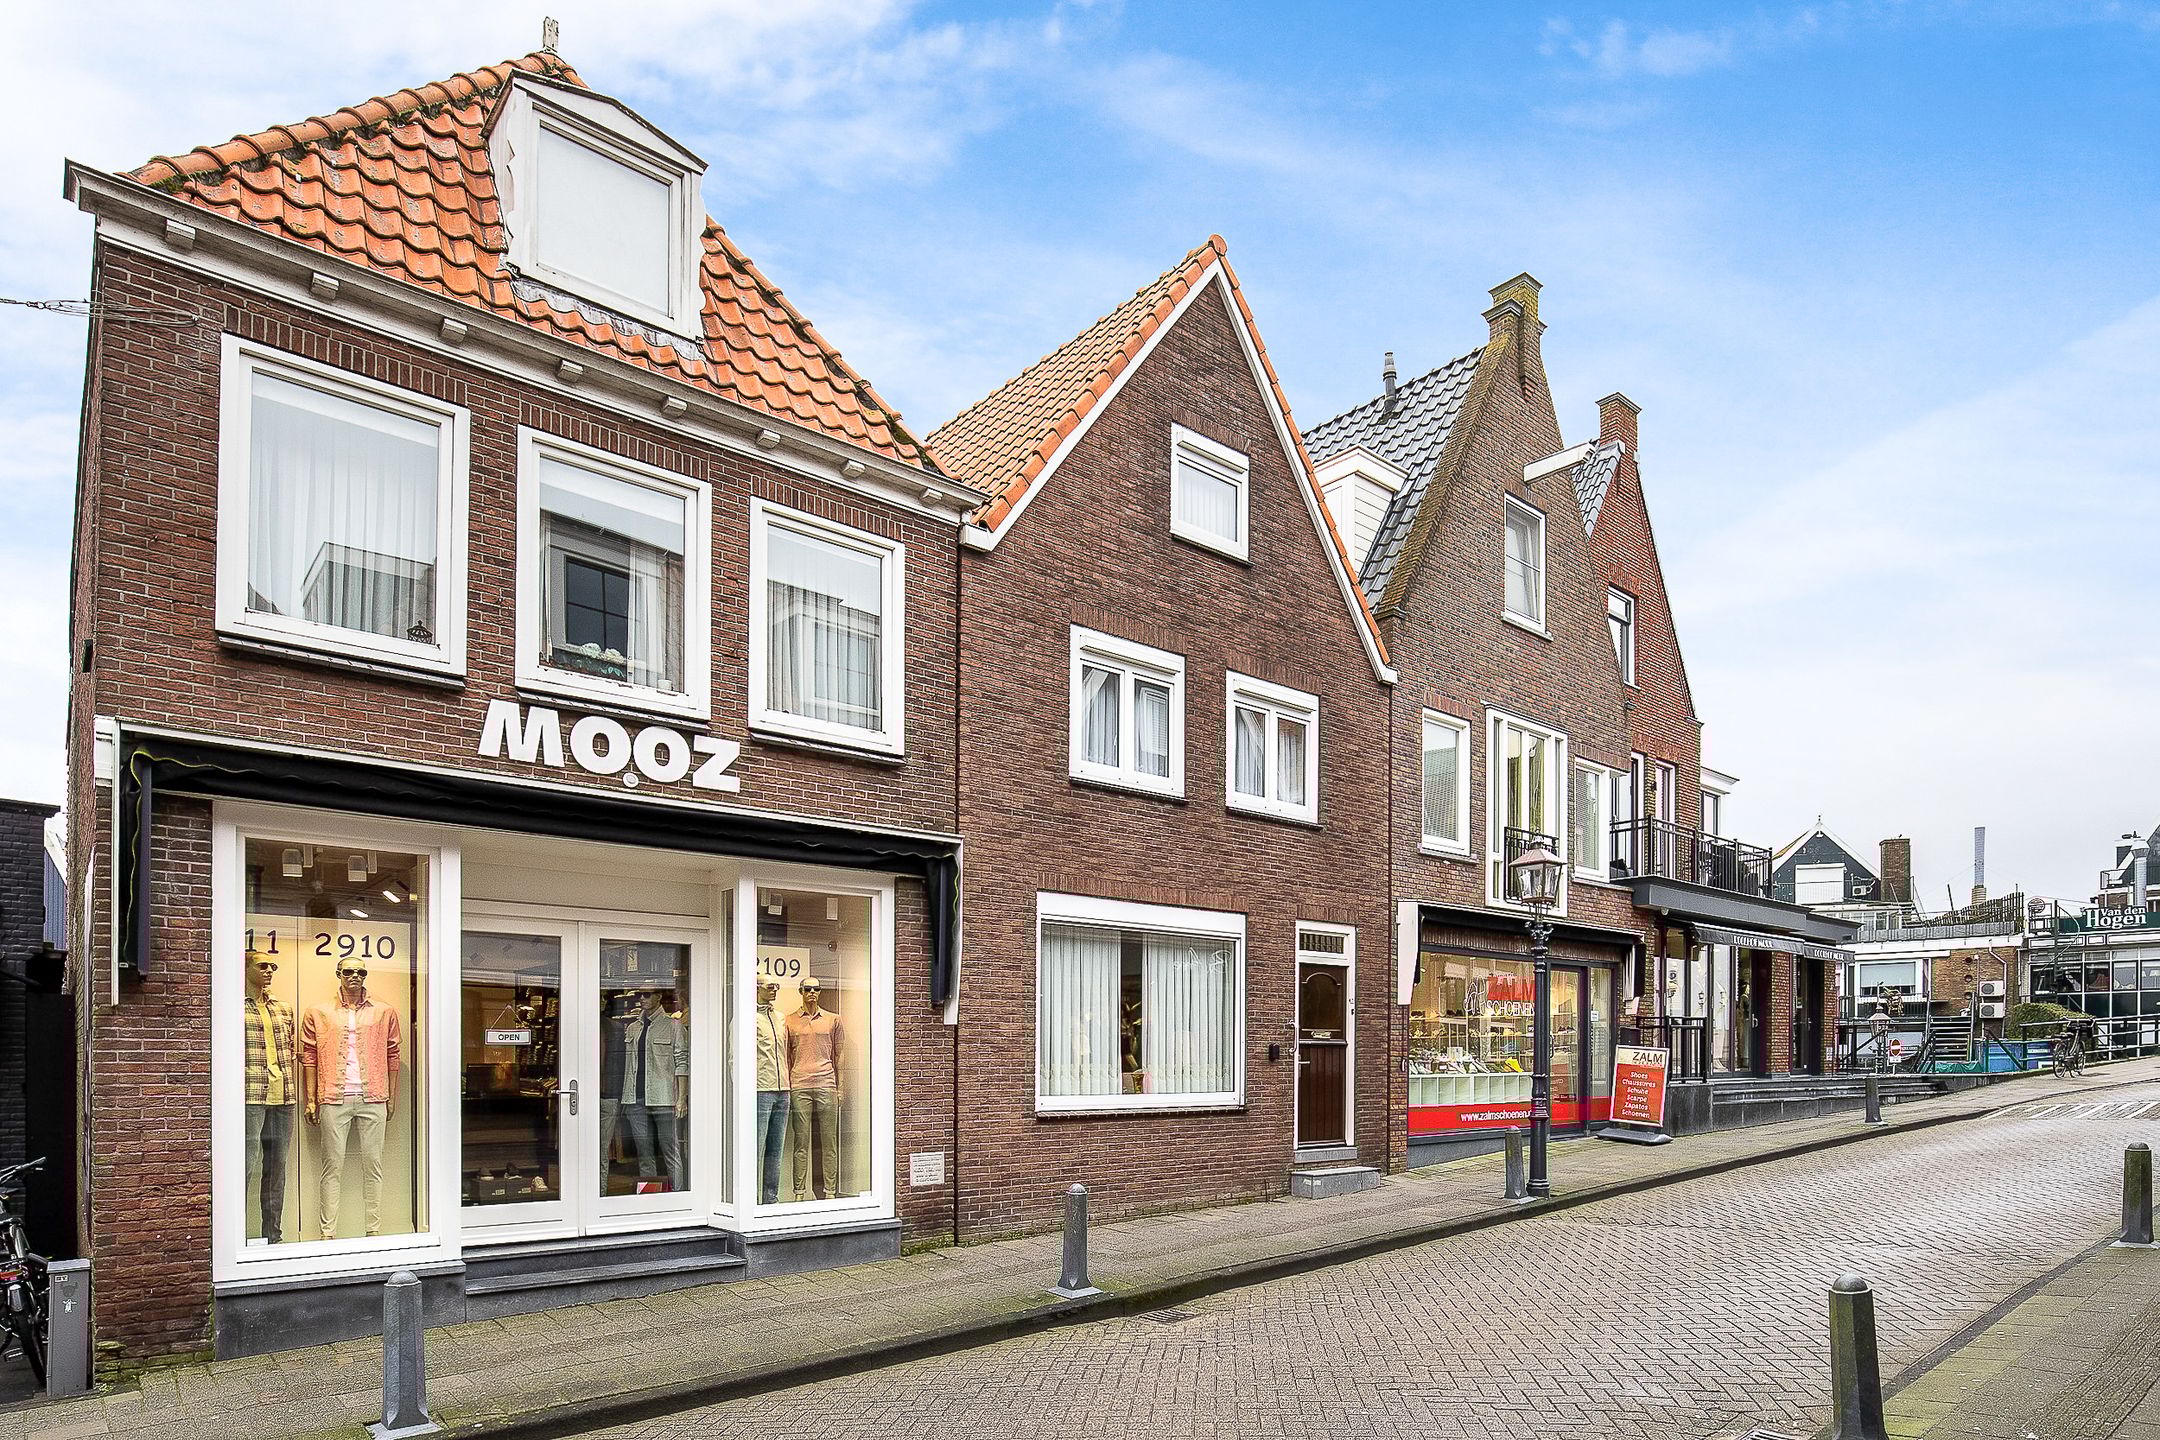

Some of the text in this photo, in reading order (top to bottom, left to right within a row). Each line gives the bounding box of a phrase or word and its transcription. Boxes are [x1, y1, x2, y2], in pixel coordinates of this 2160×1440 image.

[2085, 909, 2147, 929] Hogen
[2101, 907, 2145, 916] Van den
[315, 933, 395, 959] 2910
[756, 957, 801, 978] 109
[1488, 977, 1536, 1000] ZALM
[497, 1033, 520, 1041] OPEN
[1632, 1052, 1663, 1063] ZALM
